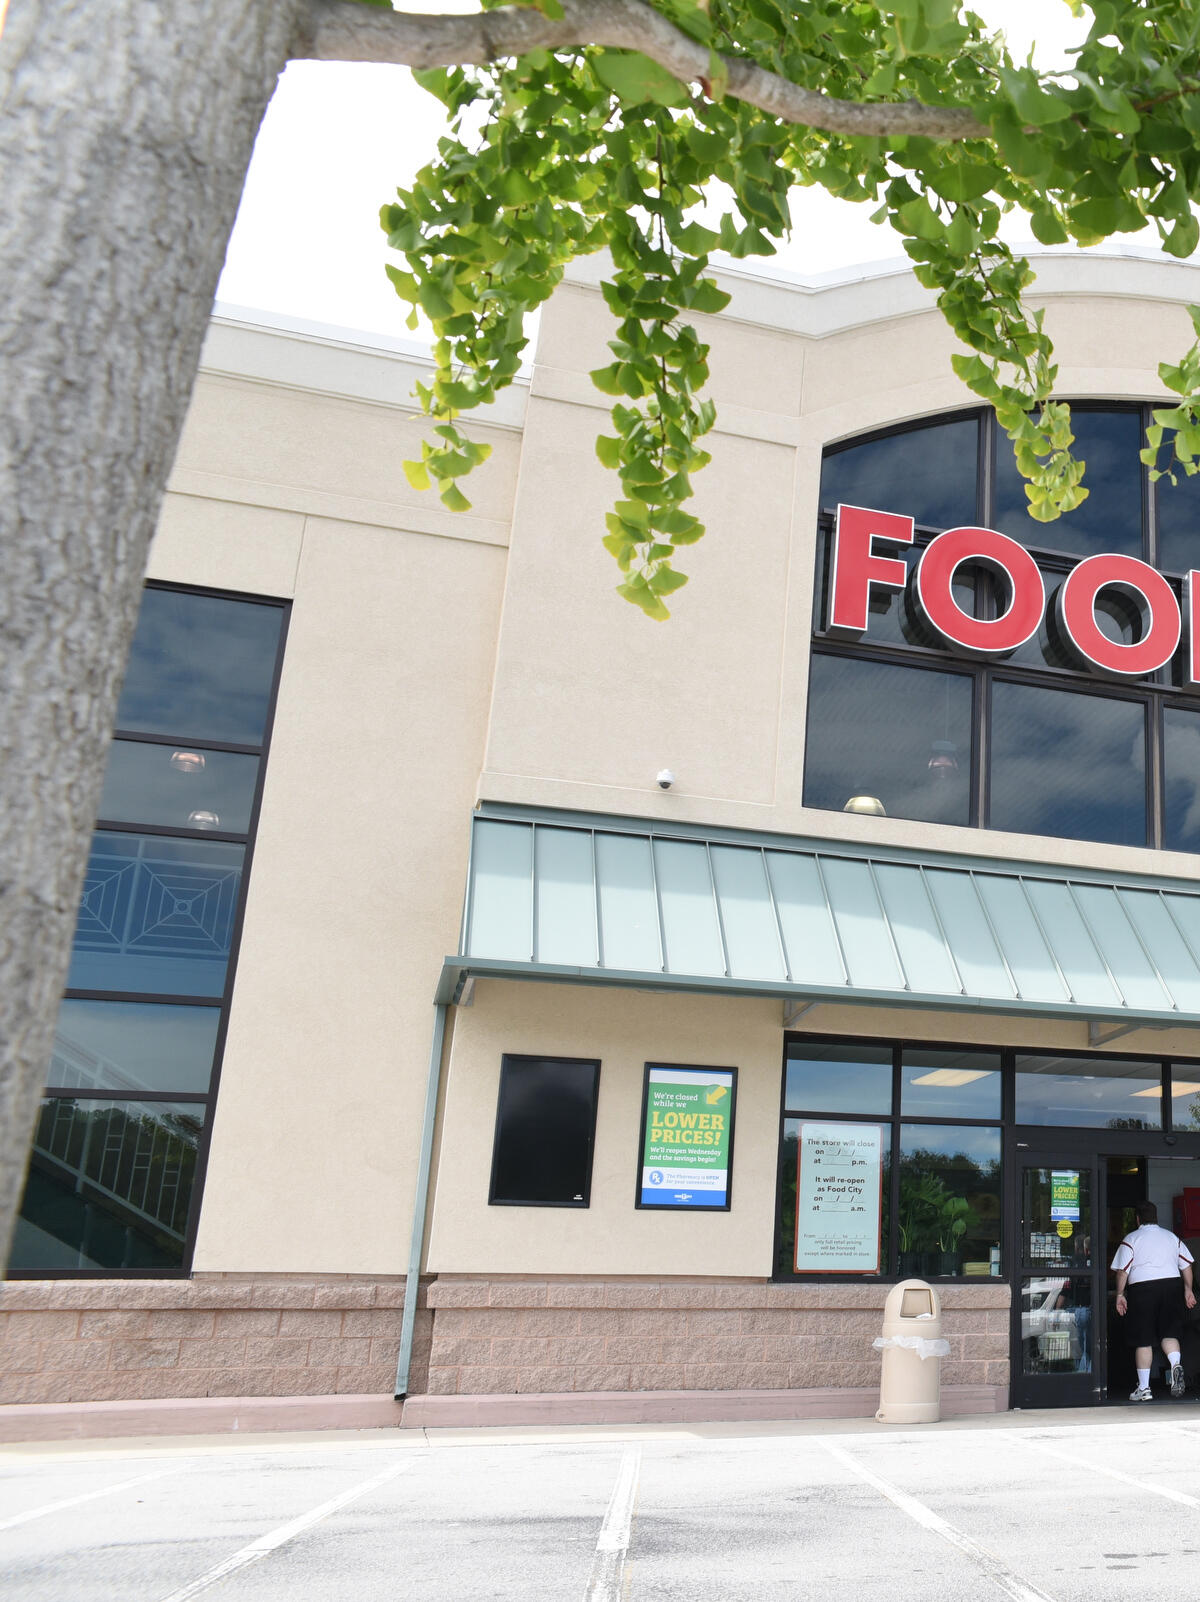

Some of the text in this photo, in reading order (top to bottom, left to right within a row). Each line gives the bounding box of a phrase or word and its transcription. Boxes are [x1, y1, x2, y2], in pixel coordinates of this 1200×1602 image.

[654, 1092, 698, 1101] We're closed
[653, 1100, 674, 1108] while
[652, 1111, 725, 1131] LOWER
[650, 1128, 721, 1146] PRICES!
[837, 1177, 865, 1185] re-open
[848, 1186, 863, 1194] City
